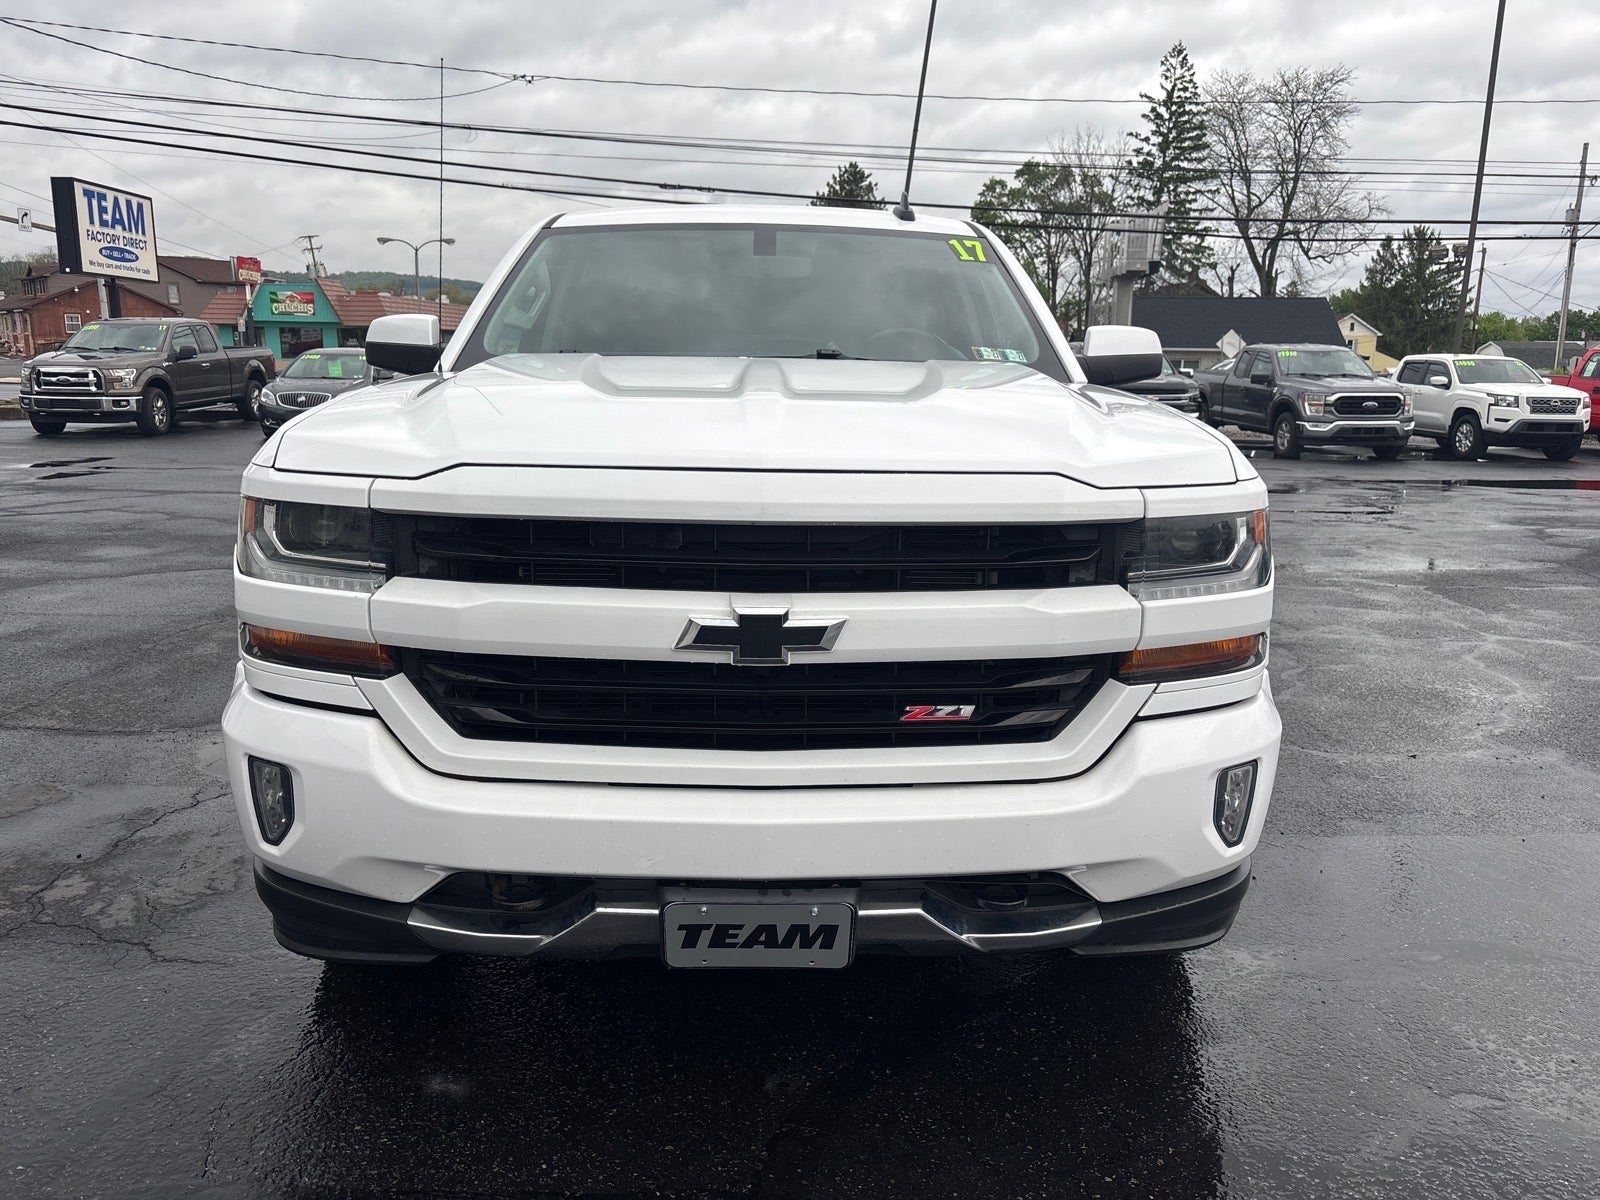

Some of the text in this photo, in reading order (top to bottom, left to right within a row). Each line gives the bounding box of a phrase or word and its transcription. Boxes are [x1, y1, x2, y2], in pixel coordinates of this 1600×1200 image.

[82, 188, 146, 236] TEAM
[86, 229, 148, 252] FACTORY DIRECT
[948, 239, 987, 261] 17
[88, 259, 96, 267] We
[97, 261, 105, 269] buy
[123, 264, 135, 272] trucks
[272, 302, 314, 314] CHUCHIS
[900, 704, 976, 721] Z71
[677, 923, 840, 950] TEAM
